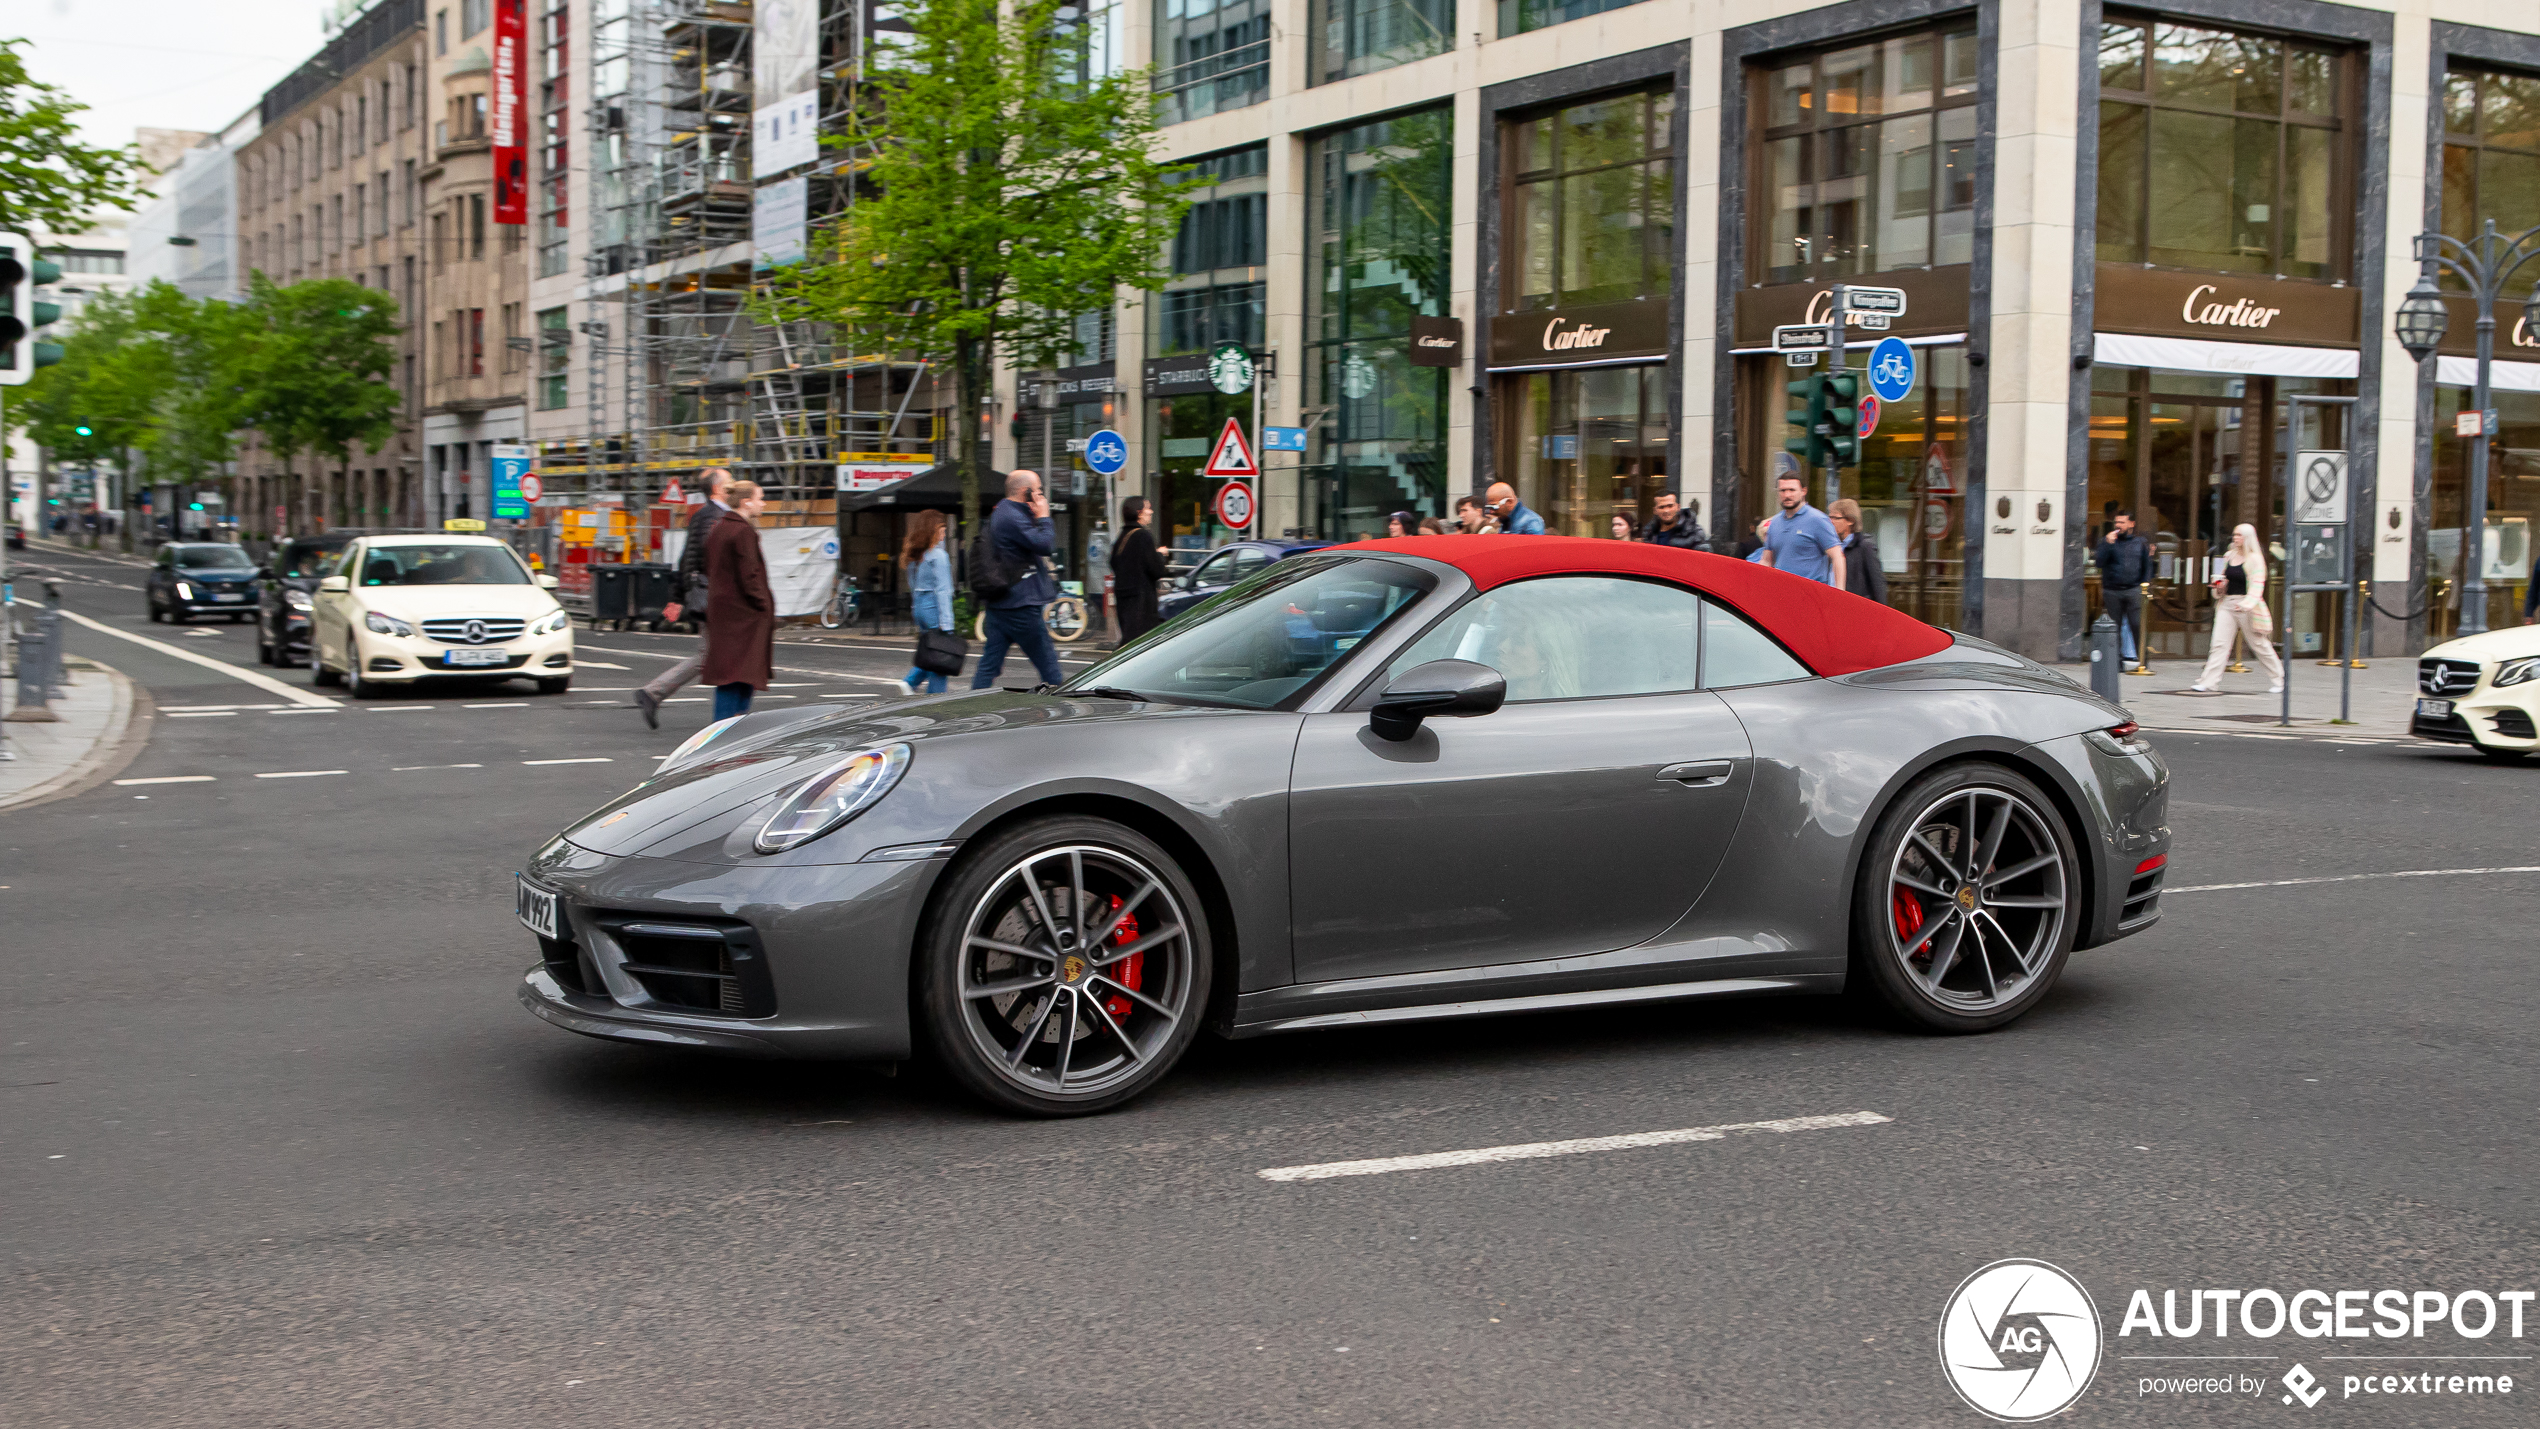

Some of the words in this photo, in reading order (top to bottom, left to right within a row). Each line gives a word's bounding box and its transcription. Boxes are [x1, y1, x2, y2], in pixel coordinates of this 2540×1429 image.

[2183, 285, 2280, 328] Cartier
[1418, 335, 1457, 348] Cartier
[1543, 317, 1611, 351] Cartier
[1225, 495, 1249, 516] 30
